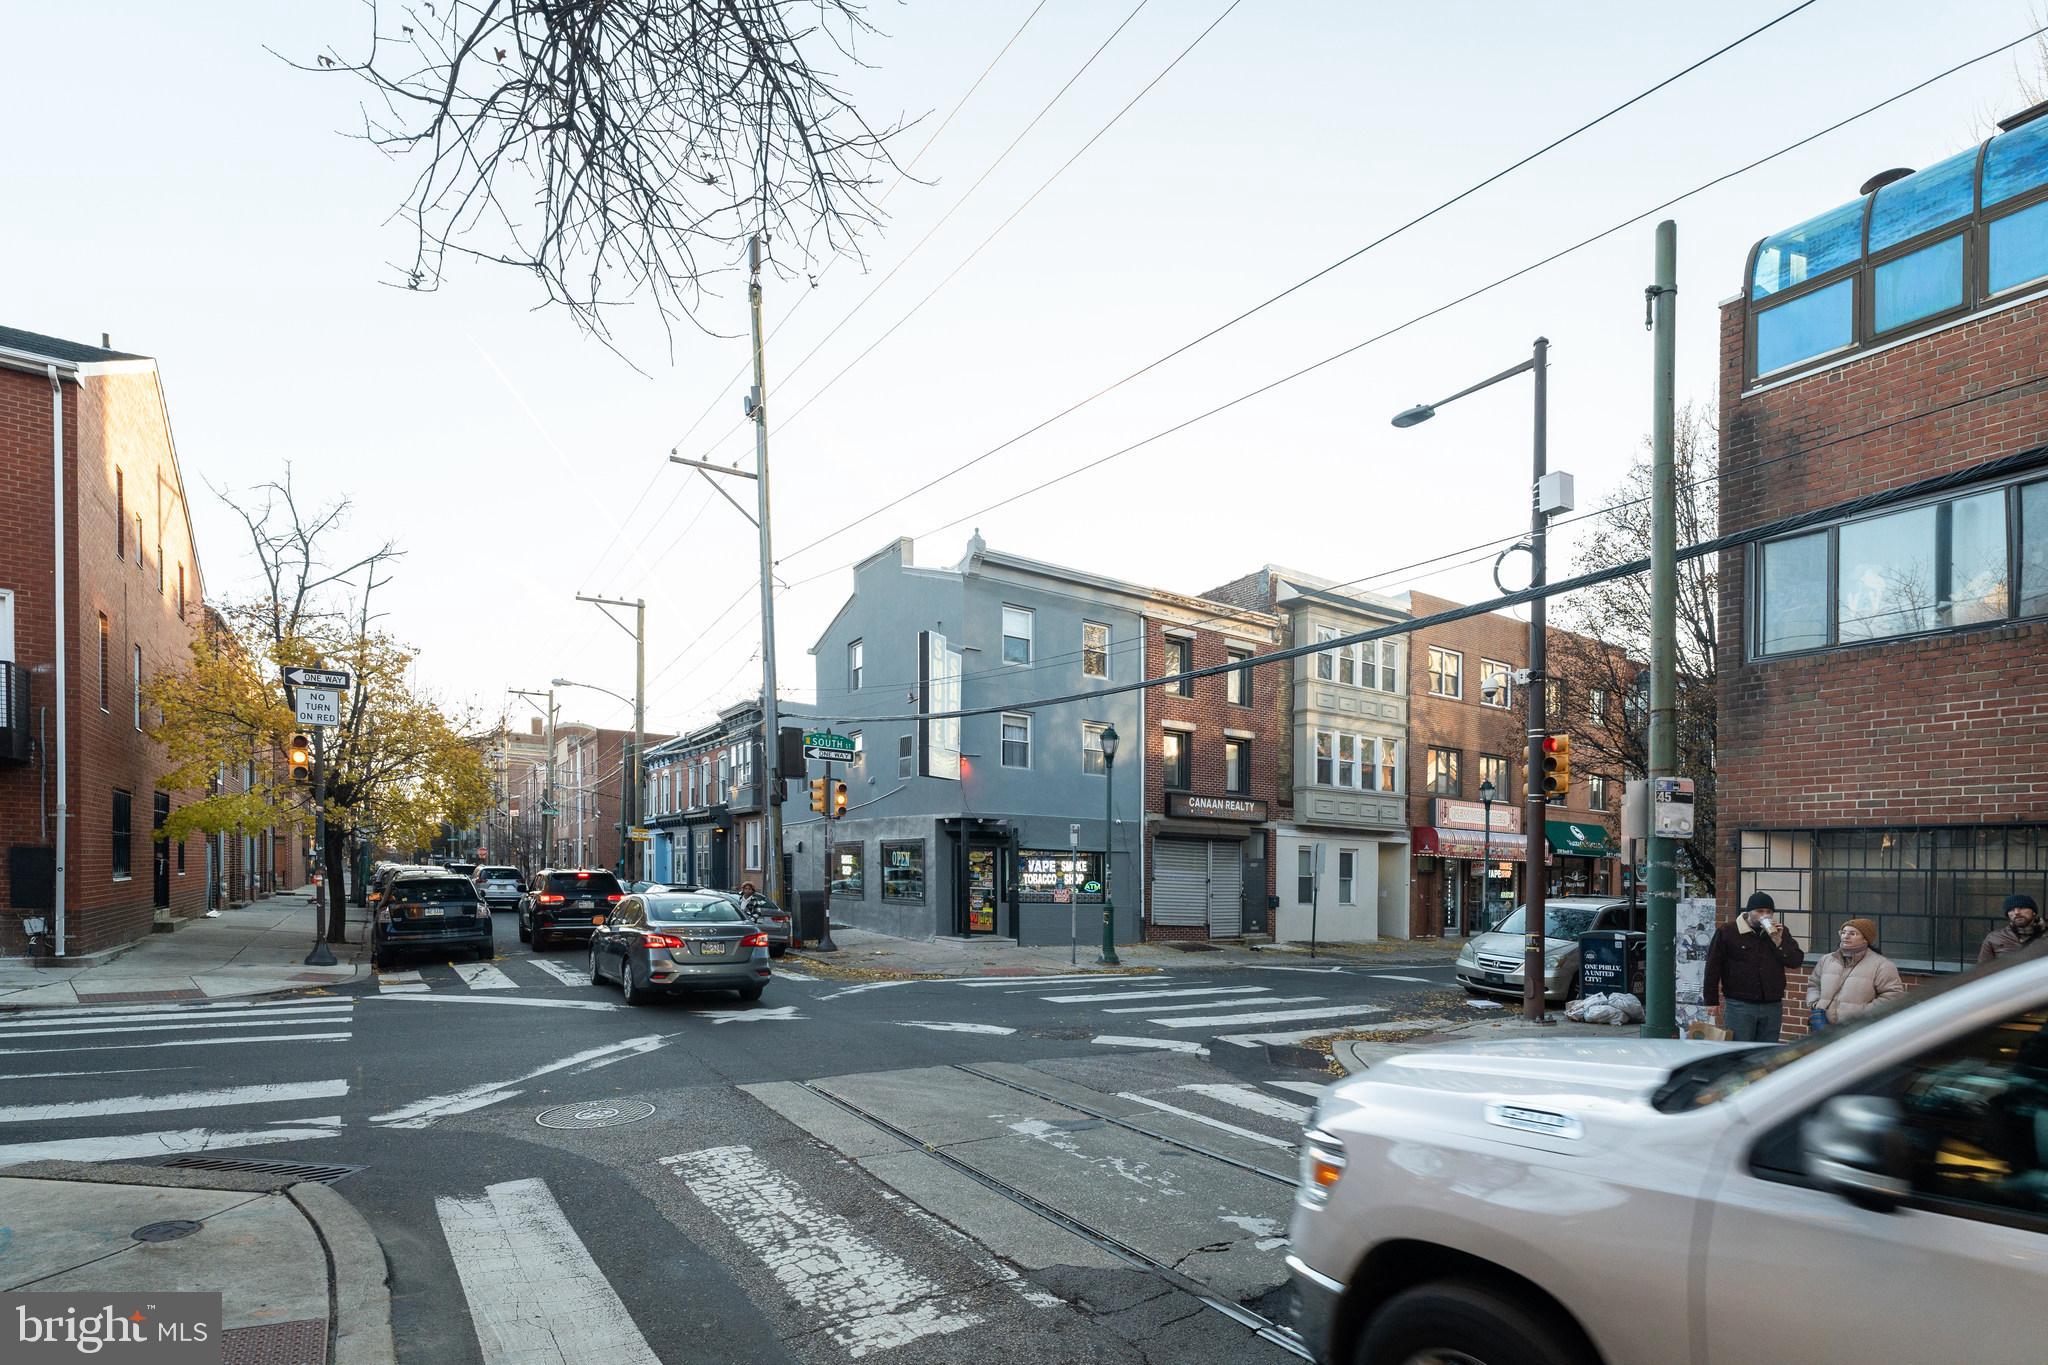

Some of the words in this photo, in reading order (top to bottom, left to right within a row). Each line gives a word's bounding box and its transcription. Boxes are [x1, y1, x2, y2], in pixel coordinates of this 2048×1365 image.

[304, 673, 321, 682] ONE
[325, 675, 343, 684] WAY
[310, 693, 325, 701] NO
[305, 702, 331, 711] TURN
[300, 712, 313, 720] ON
[316, 713, 336, 722] RED
[812, 737, 843, 749] SOUTH
[819, 750, 832, 758] ONE
[1658, 791, 1671, 802] 45
[1189, 797, 1224, 809] CANAAN
[1225, 800, 1255, 812] REALTY
[892, 850, 911, 867] OPEN
[1028, 860, 1056, 872] VAPE
[1022, 873, 1057, 885] TOBACCO
[1084, 882, 1101, 891] ATM
[1599, 964, 1622, 972] PHILLY,
